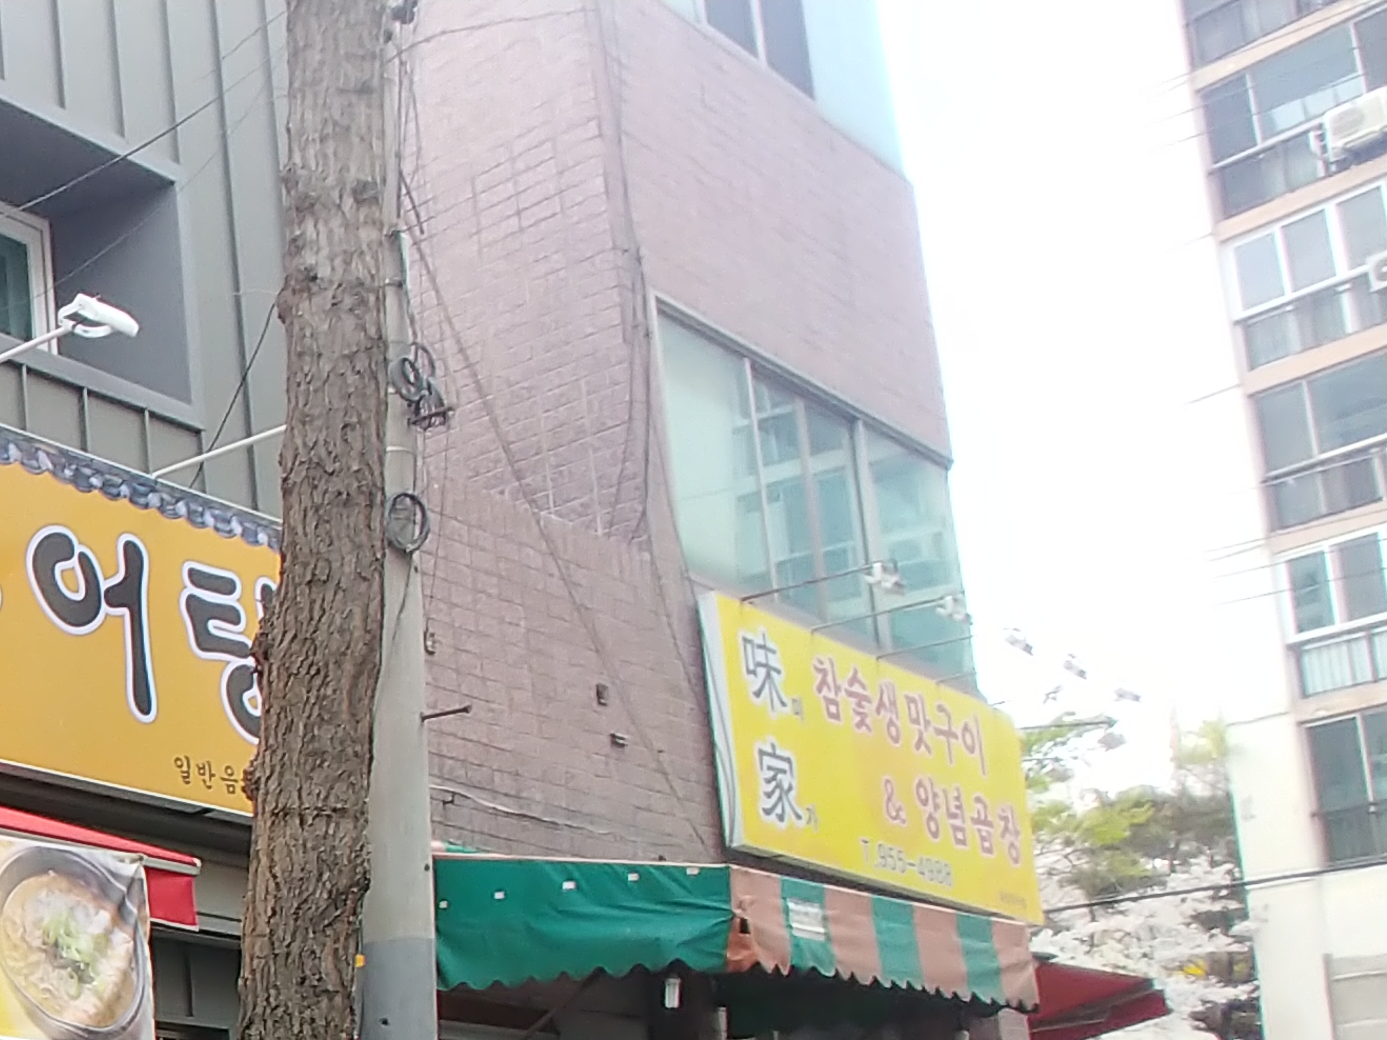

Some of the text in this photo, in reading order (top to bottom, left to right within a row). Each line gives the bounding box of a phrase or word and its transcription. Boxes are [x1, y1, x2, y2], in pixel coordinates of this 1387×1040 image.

[742, 633, 787, 713] 味
[758, 742, 802, 823] 家
[914, 776, 1022, 866] 양념곱창
